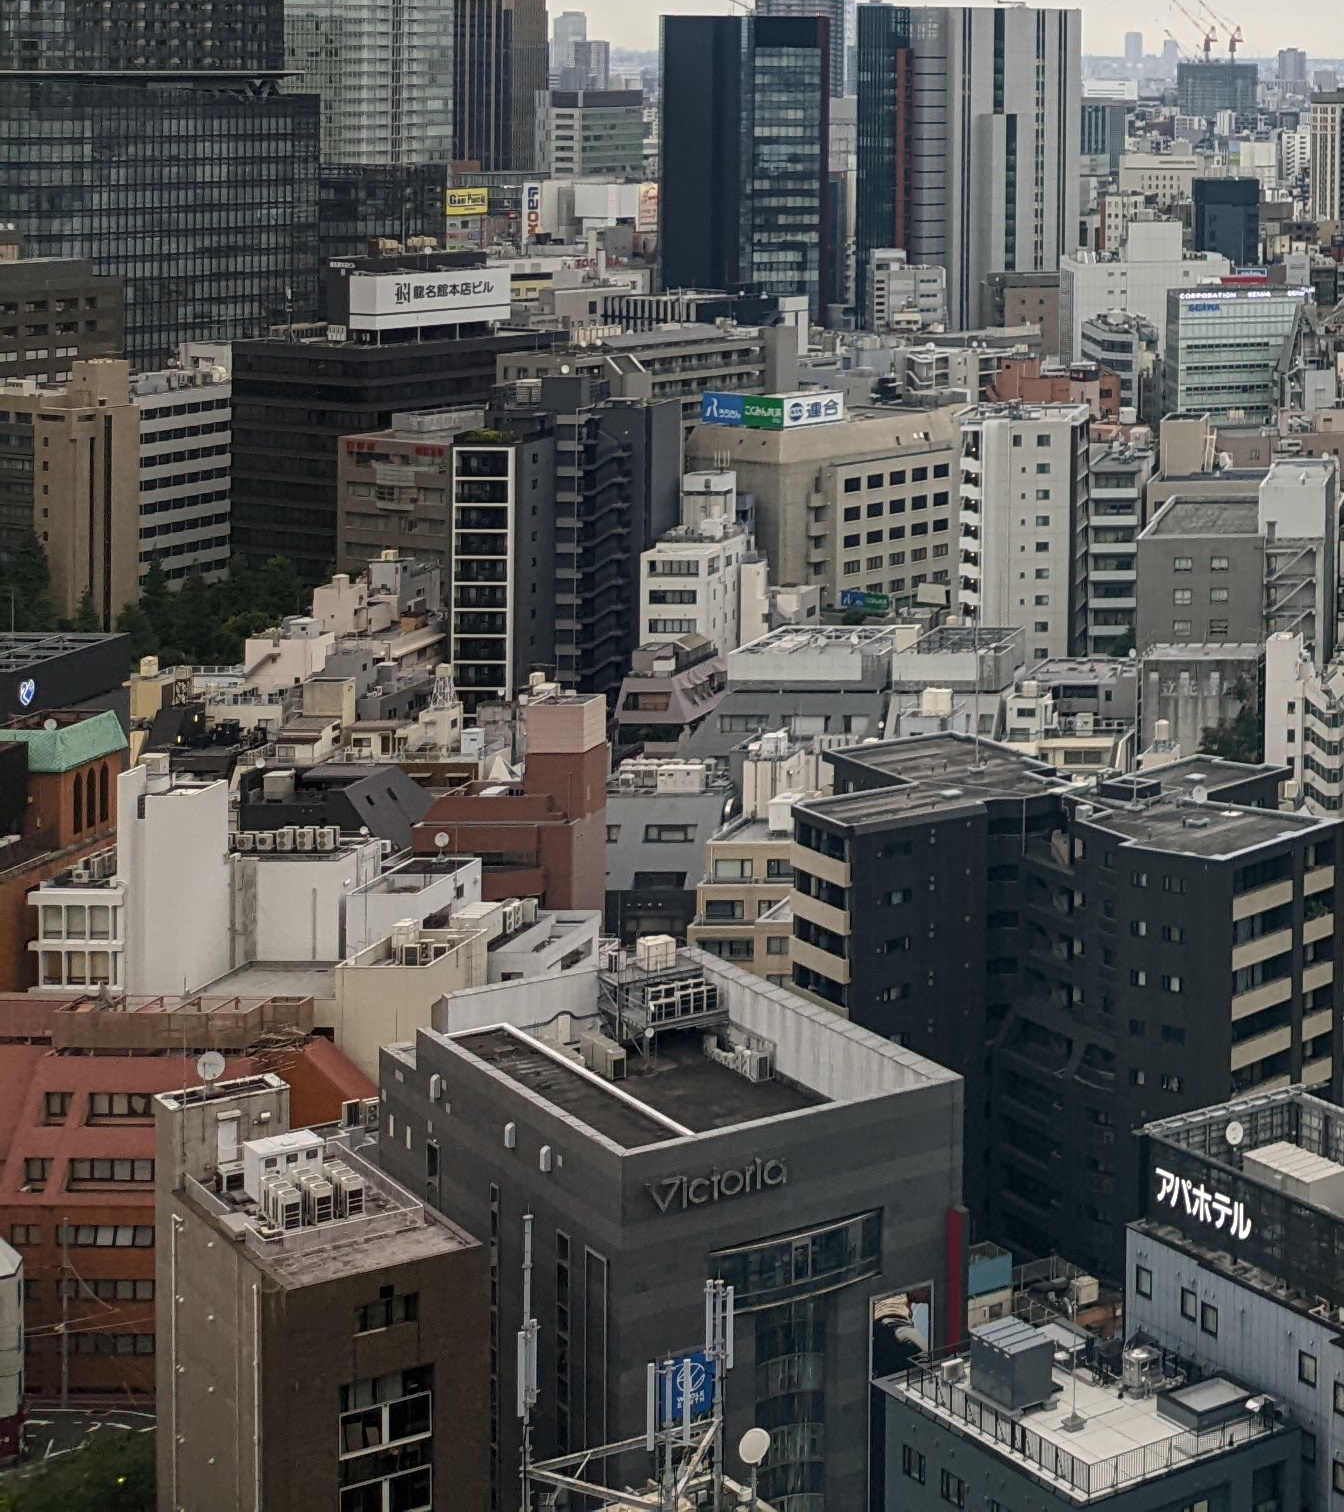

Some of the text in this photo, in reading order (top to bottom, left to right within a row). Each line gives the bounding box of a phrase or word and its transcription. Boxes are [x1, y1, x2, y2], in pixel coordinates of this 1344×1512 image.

[413, 280, 495, 300] 龍名館本店ビル
[805, 398, 840, 419] 連合
[643, 1156, 788, 1213] Victoria
[1154, 1167, 1253, 1240] アパホテル
